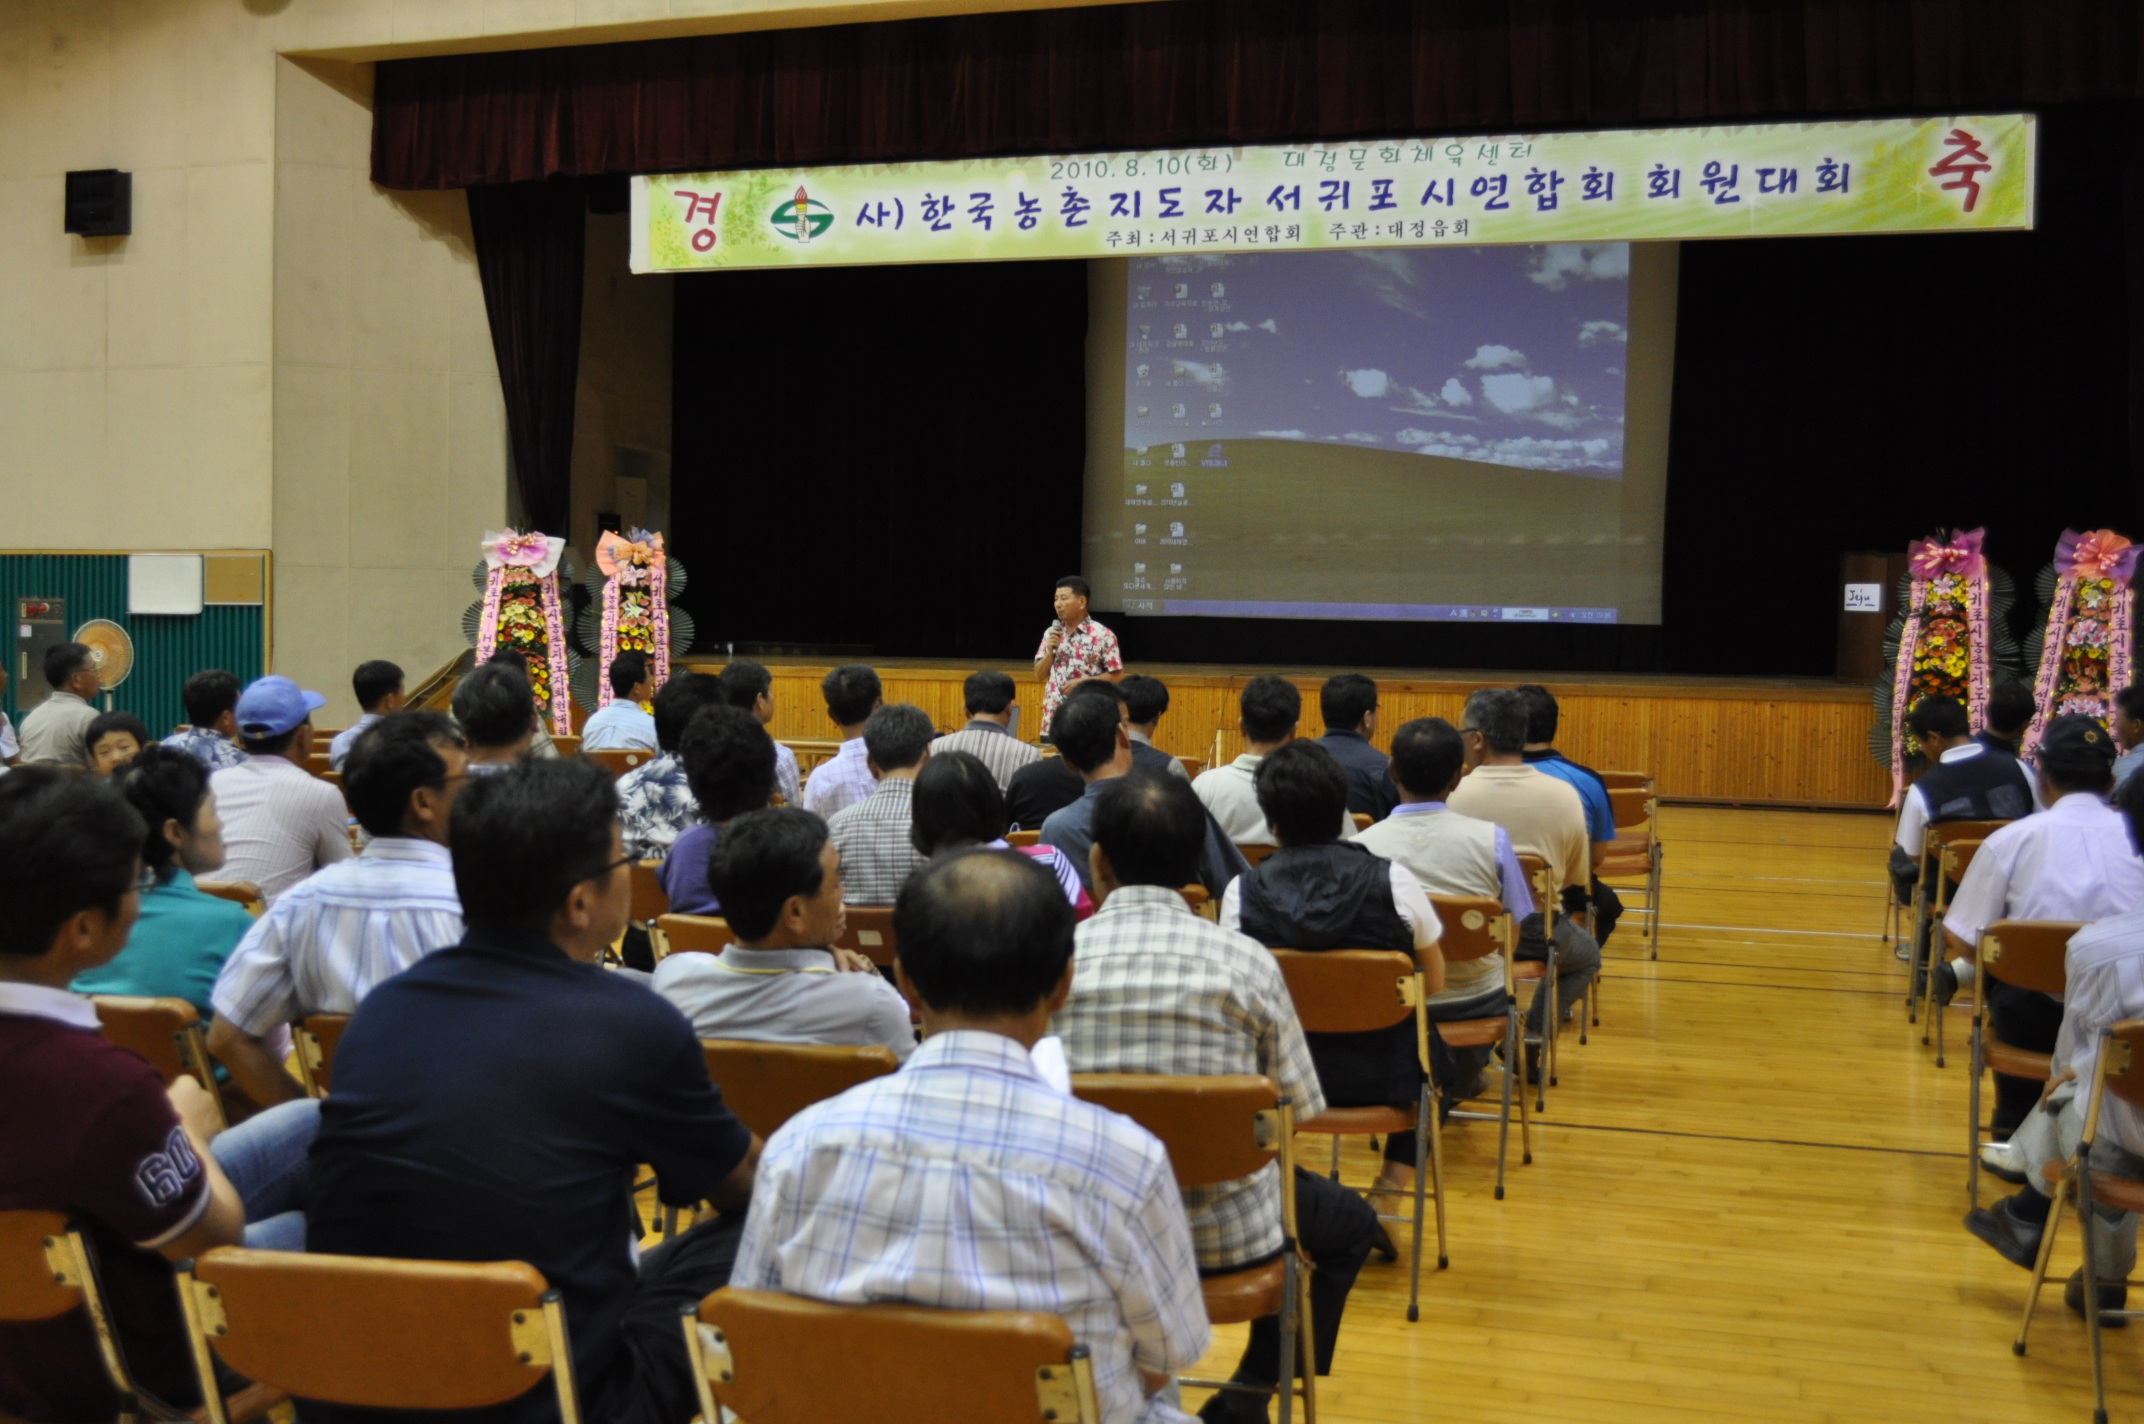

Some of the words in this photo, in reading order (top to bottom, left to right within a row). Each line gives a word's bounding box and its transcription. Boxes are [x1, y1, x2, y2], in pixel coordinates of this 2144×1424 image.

[1647, 157, 1850, 204] 회원대회
[1929, 128, 1992, 213] 축
[674, 190, 722, 252] 경
[1848, 588, 1870, 607] Jeju
[135, 1125, 202, 1207] 60
